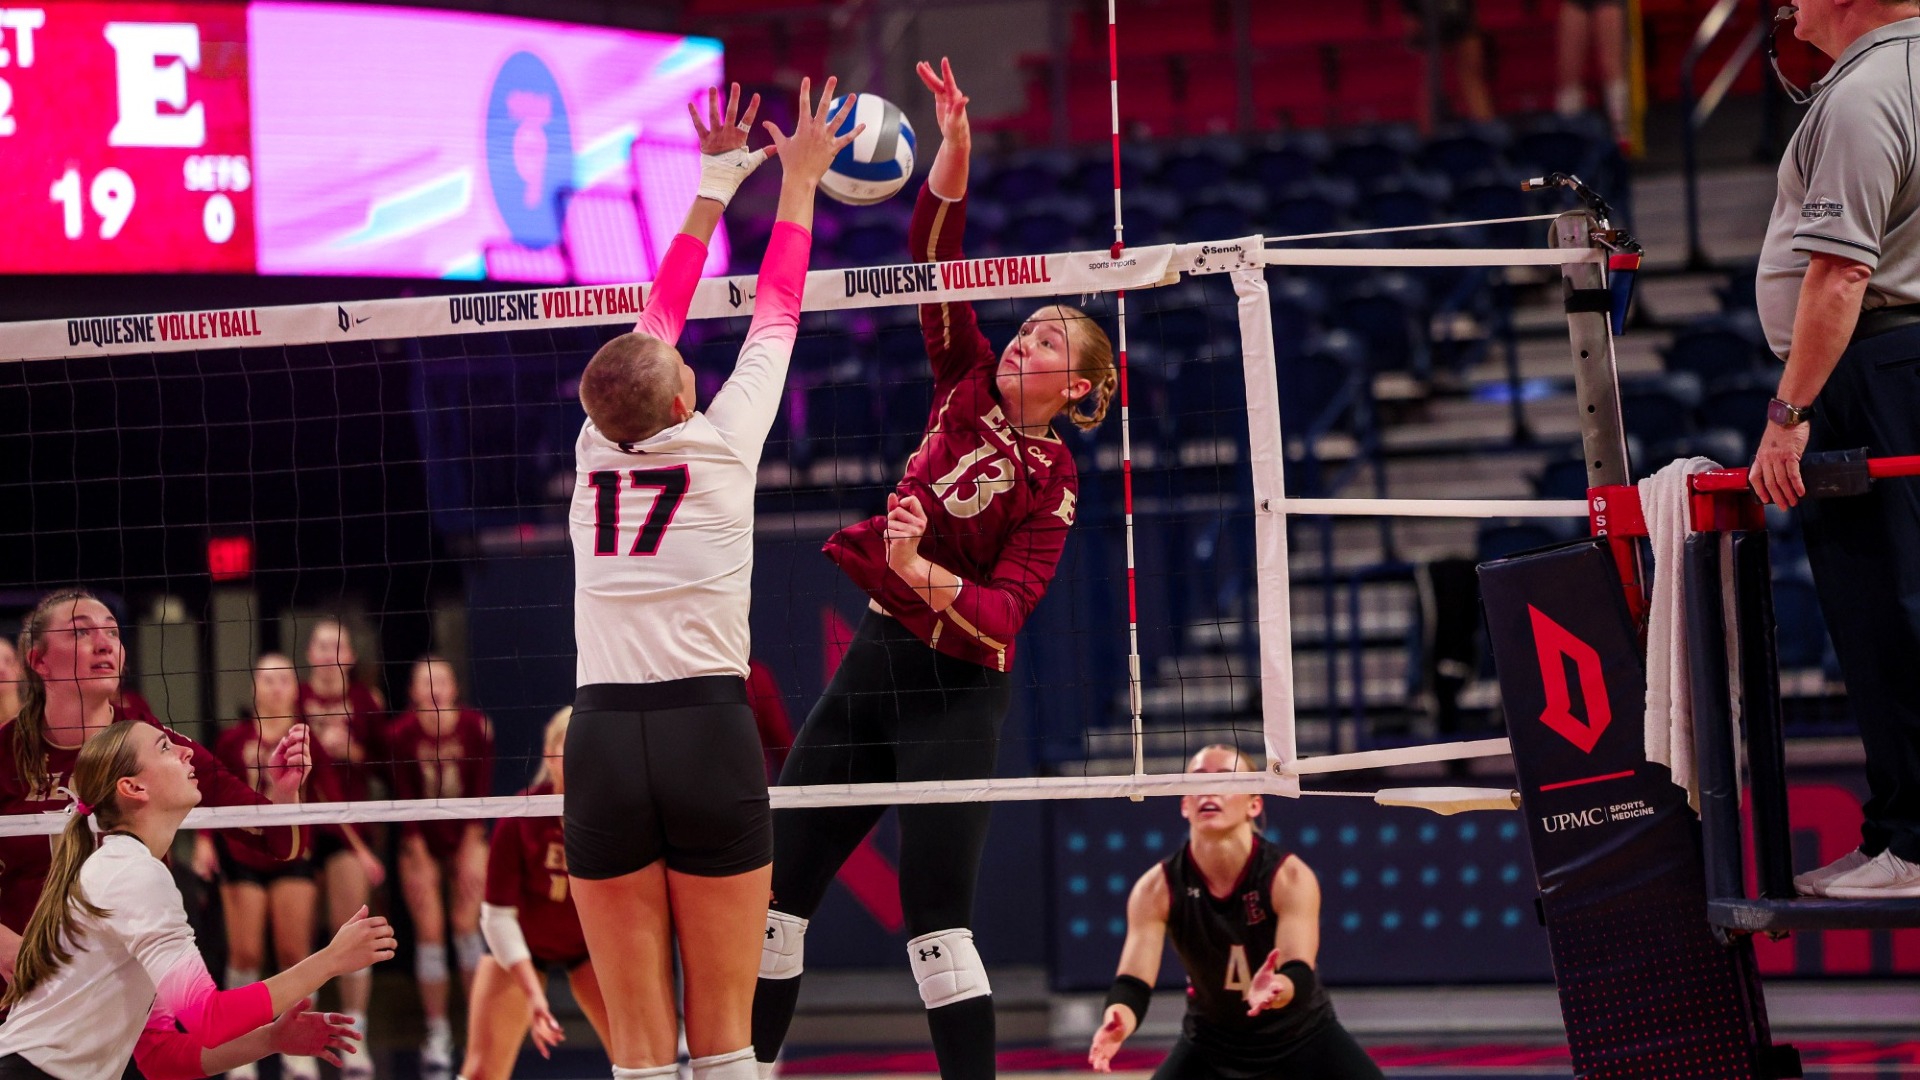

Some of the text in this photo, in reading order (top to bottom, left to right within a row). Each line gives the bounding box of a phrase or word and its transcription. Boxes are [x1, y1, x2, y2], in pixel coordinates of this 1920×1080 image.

[104, 22, 206, 147] E
[50, 166, 136, 240] 19
[203, 193, 235, 243] 0
[1089, 259, 1136, 270] sports imports
[1210, 244, 1242, 255] Senoh
[844, 256, 1051, 298] DUQUESNE VOLLEYBALL
[450, 286, 645, 325] DUQUESNE VOLLEYBALL
[67, 310, 262, 347] DUQUESNE VOLLEYBALL
[1027, 445, 1053, 468] CAA
[929, 436, 1016, 519] 13
[588, 464, 691, 556] 17
[1542, 807, 1604, 833] UPMC
[1609, 800, 1645, 813] SPORTS
[1611, 807, 1655, 821] MEDICINE
[1224, 944, 1252, 1001] 4
